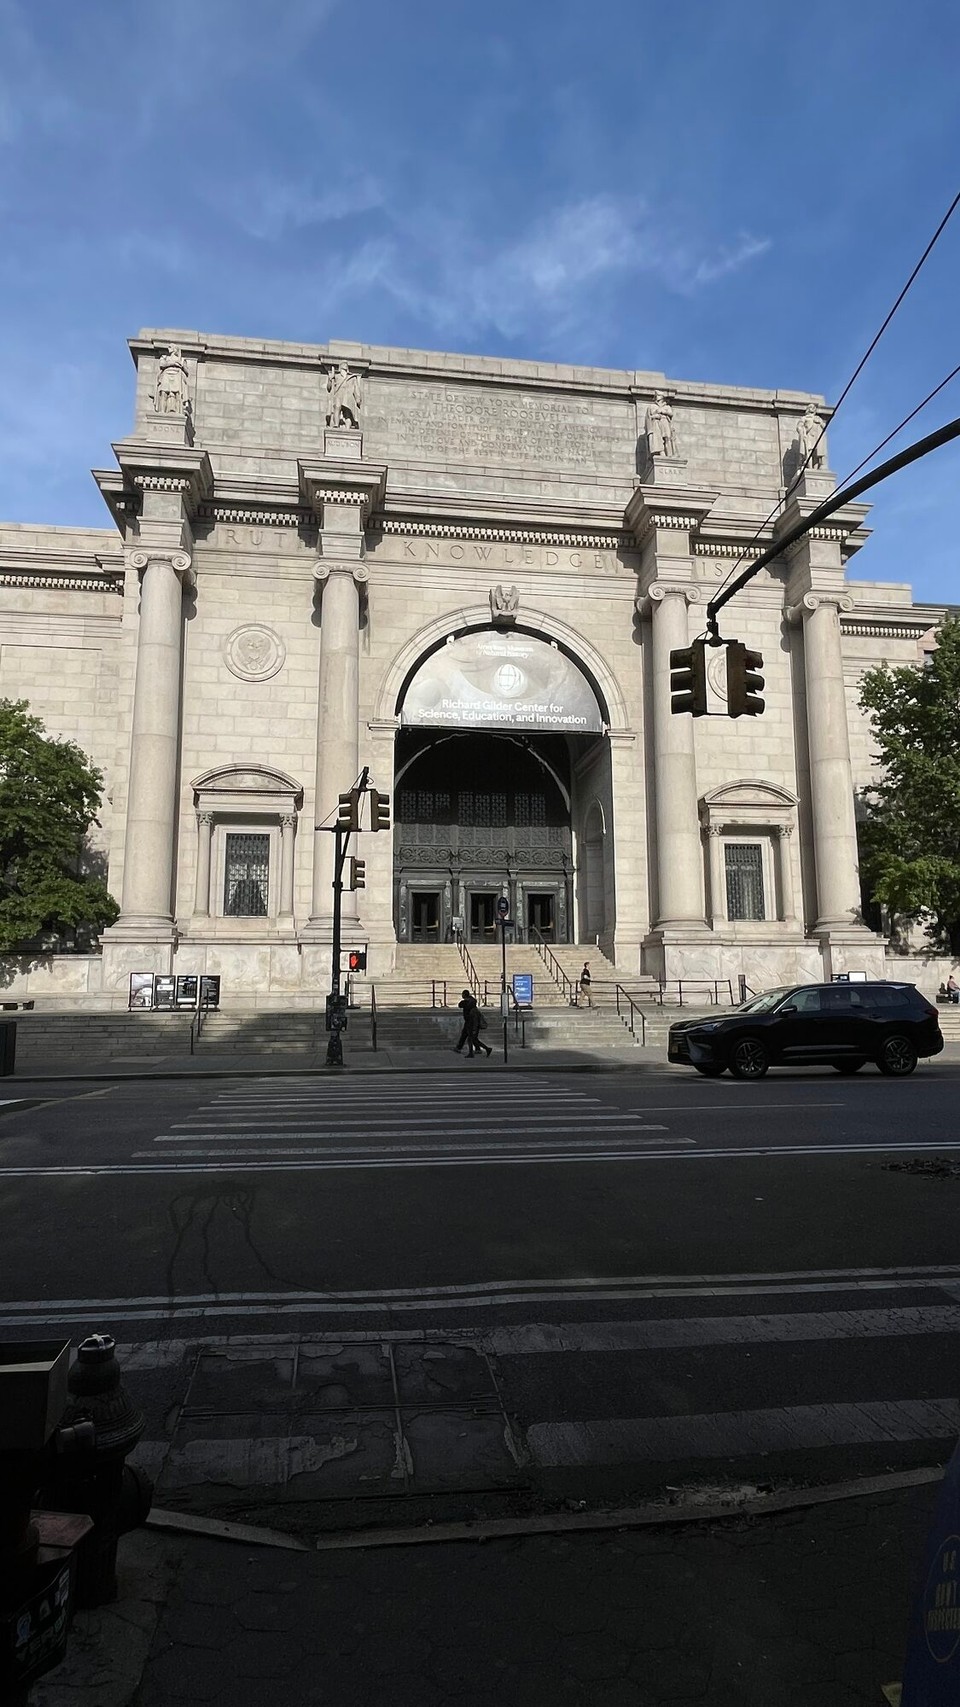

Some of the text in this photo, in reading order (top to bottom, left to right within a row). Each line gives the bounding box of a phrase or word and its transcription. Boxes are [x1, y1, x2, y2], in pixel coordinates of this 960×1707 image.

[411, 390, 440, 401] STATE
[463, 396, 483, 404] NEW
[489, 398, 515, 407] YORK
[521, 401, 572, 413] MEMORIAL
[575, 406, 588, 414] TO
[433, 402, 568, 423] THEODORE ROOSEVELT
[507, 427, 522, 435] THE
[516, 420, 544, 428] YOUTH
[564, 424, 600, 434] AMERICA
[459, 439, 476, 447] AND
[481, 440, 550, 453] CONSERVATION
[495, 433, 526, 443] RIGHTS
[565, 440, 594, 449] PEOPLE
[402, 540, 603, 568] KNOWLEDGE
[442, 700, 563, 713] Richard Gilder Center for
[418, 709, 587, 725] Science, Education, and Innovation
